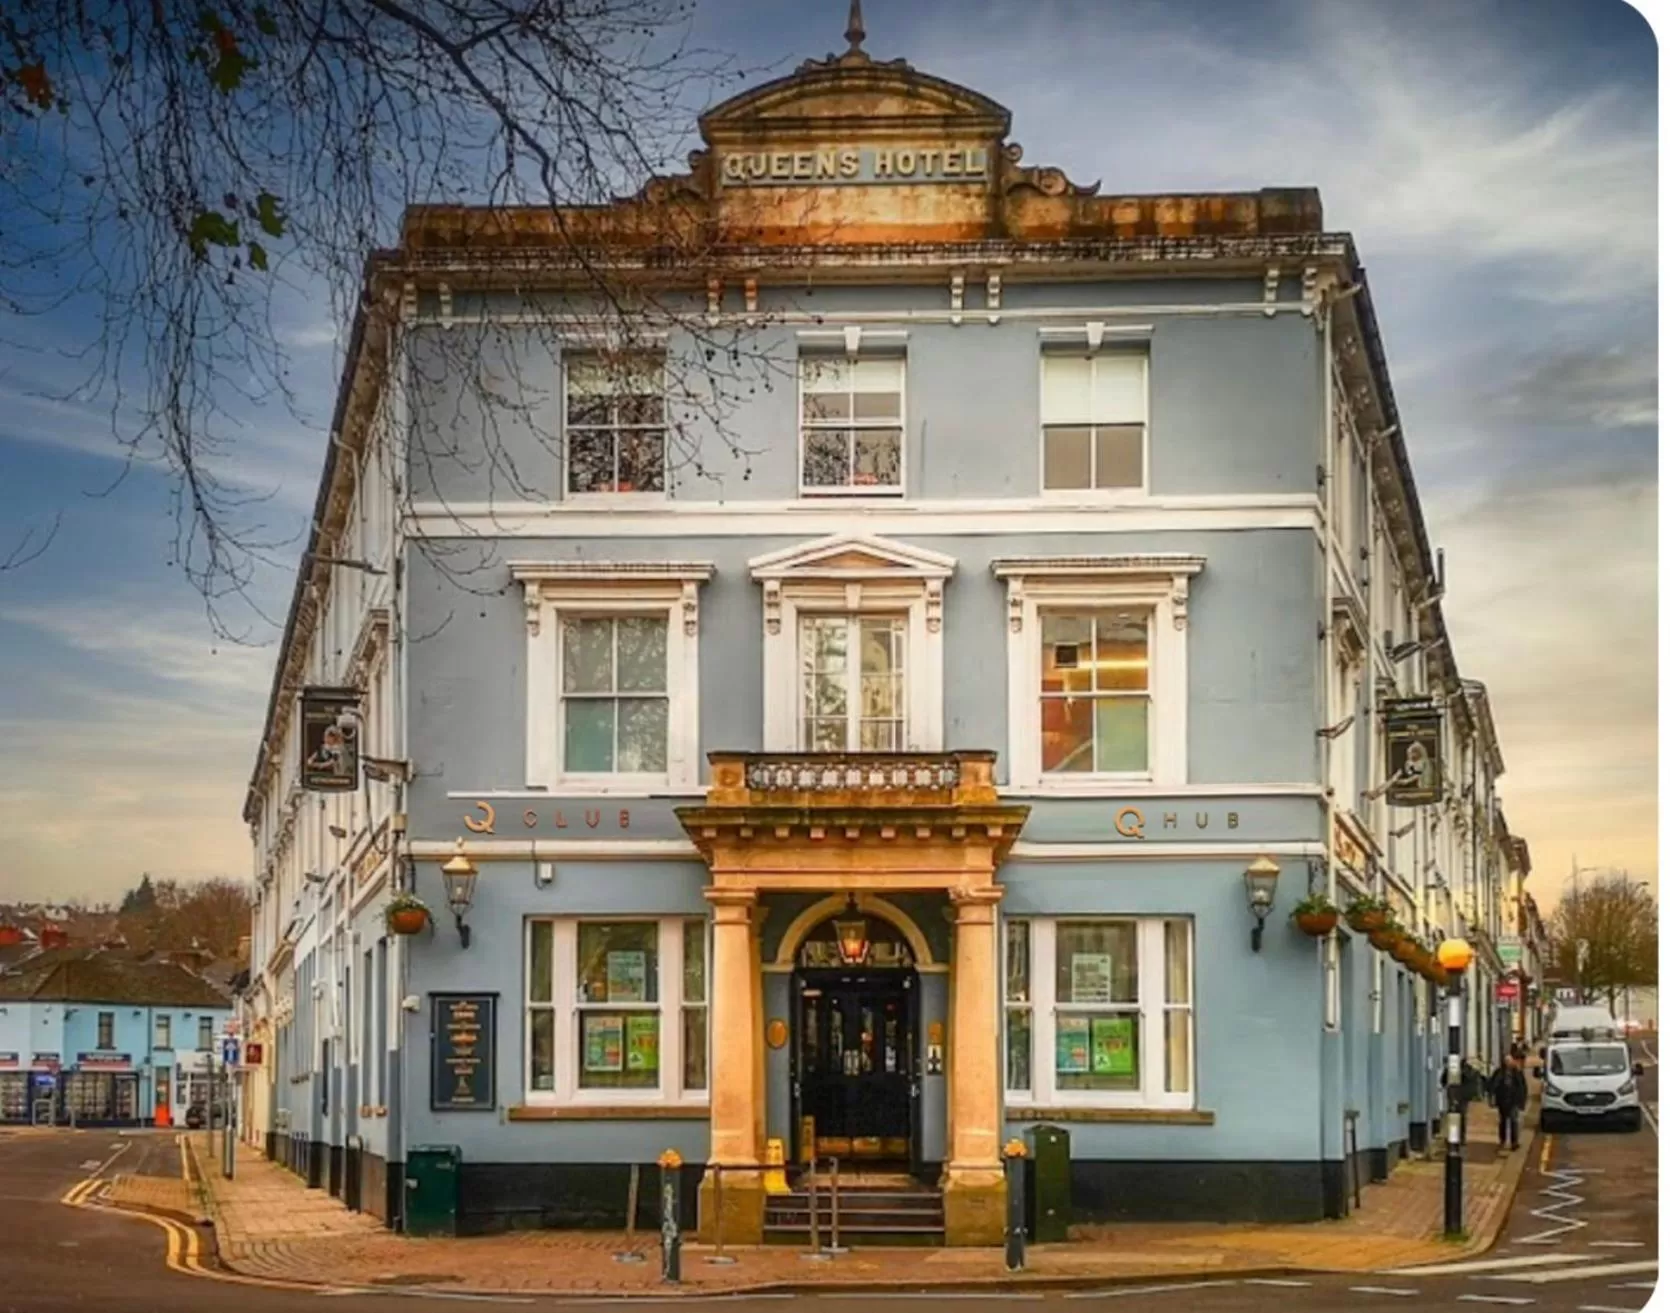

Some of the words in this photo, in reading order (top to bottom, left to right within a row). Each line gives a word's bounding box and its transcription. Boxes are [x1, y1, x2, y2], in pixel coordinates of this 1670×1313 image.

[723, 151, 860, 182] QUEENS
[873, 149, 985, 178] HOTEL
[464, 801, 496, 835] Q
[523, 808, 631, 829] CLUB
[1114, 805, 1146, 840] Q
[1163, 811, 1240, 830] HUB
